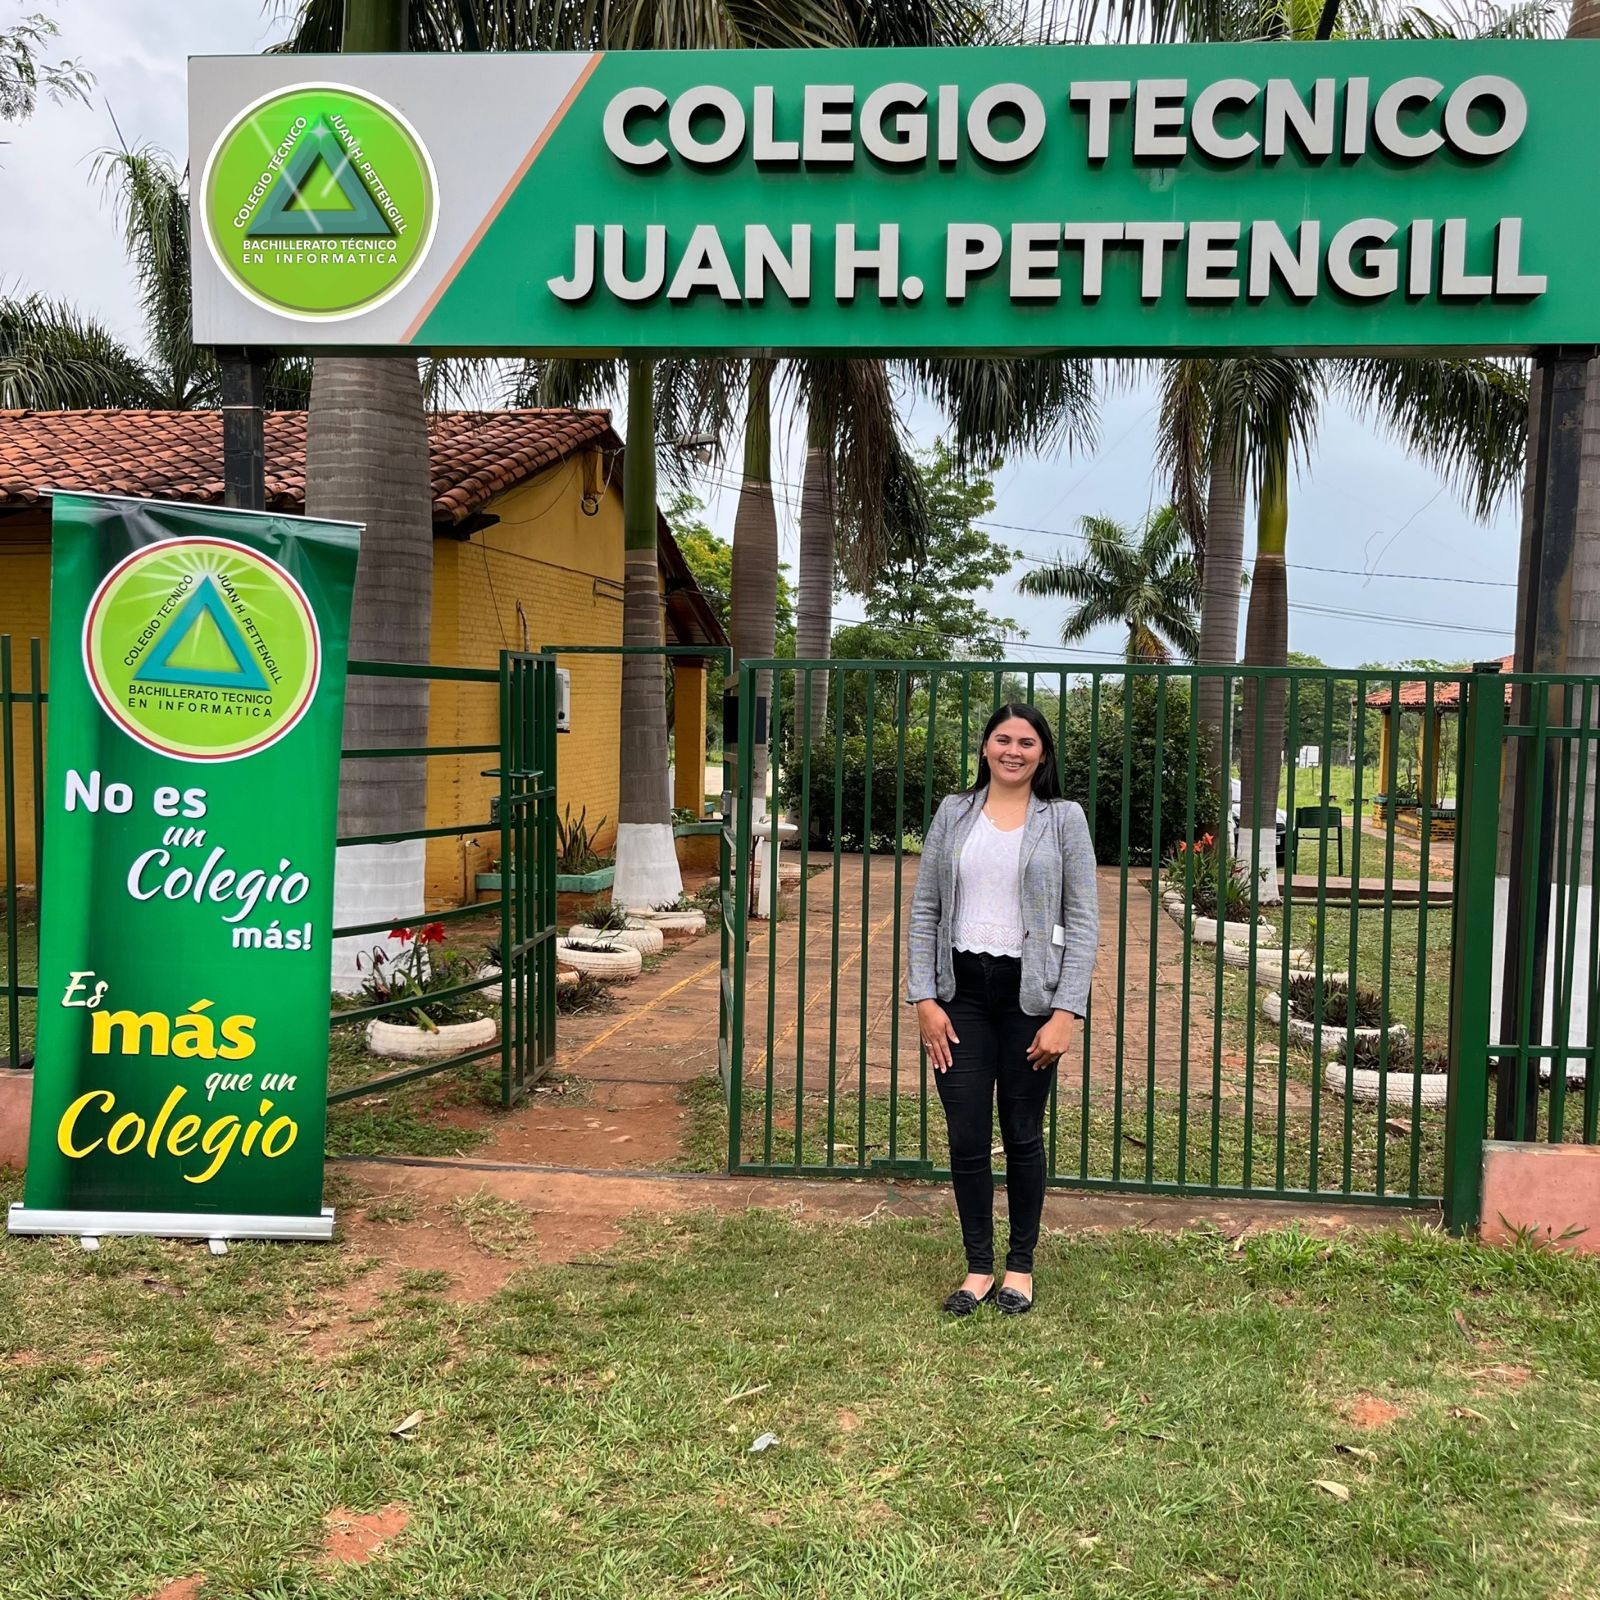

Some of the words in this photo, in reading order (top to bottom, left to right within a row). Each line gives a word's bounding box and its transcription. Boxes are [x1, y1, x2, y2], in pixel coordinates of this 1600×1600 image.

[602, 82, 1047, 166] COLEGIO
[1069, 75, 1529, 160] TECNICO
[233, 172, 273, 228] COLEGIO
[267, 116, 307, 173] TECNICO
[330, 115, 358, 153] JUAN
[351, 147, 363, 164] H.
[361, 162, 408, 234] PETTENGILL
[242, 239, 337, 250] BACHILLERATO
[340, 237, 398, 251] TÉCNICO
[242, 253, 265, 265] EN
[276, 253, 398, 264] INFORMATICA
[546, 224, 811, 301] JUAN
[835, 222, 926, 300] H.
[945, 217, 1549, 299] PETTENGILL
[123, 618, 161, 667] COLEGIO
[156, 574, 194, 622] TECNICO
[217, 573, 240, 604] JUAN
[233, 603, 245, 618] H.
[242, 617, 283, 685] PETTENGILL
[128, 684, 219, 701] BACHILLERATO
[221, 691, 273, 705] TECNICO
[128, 697, 148, 709] EN
[158, 701, 272, 717] INFORMATICA
[64, 769, 133, 813] No
[153, 786, 208, 818] es
[162, 825, 207, 848] un
[126, 847, 311, 922] Colegio
[231, 921, 313, 951] más!
[61, 971, 109, 1008] Es
[91, 998, 257, 1059] más
[204, 1072, 252, 1101] que
[260, 1072, 297, 1092] un
[57, 1085, 299, 1184] Colegio
